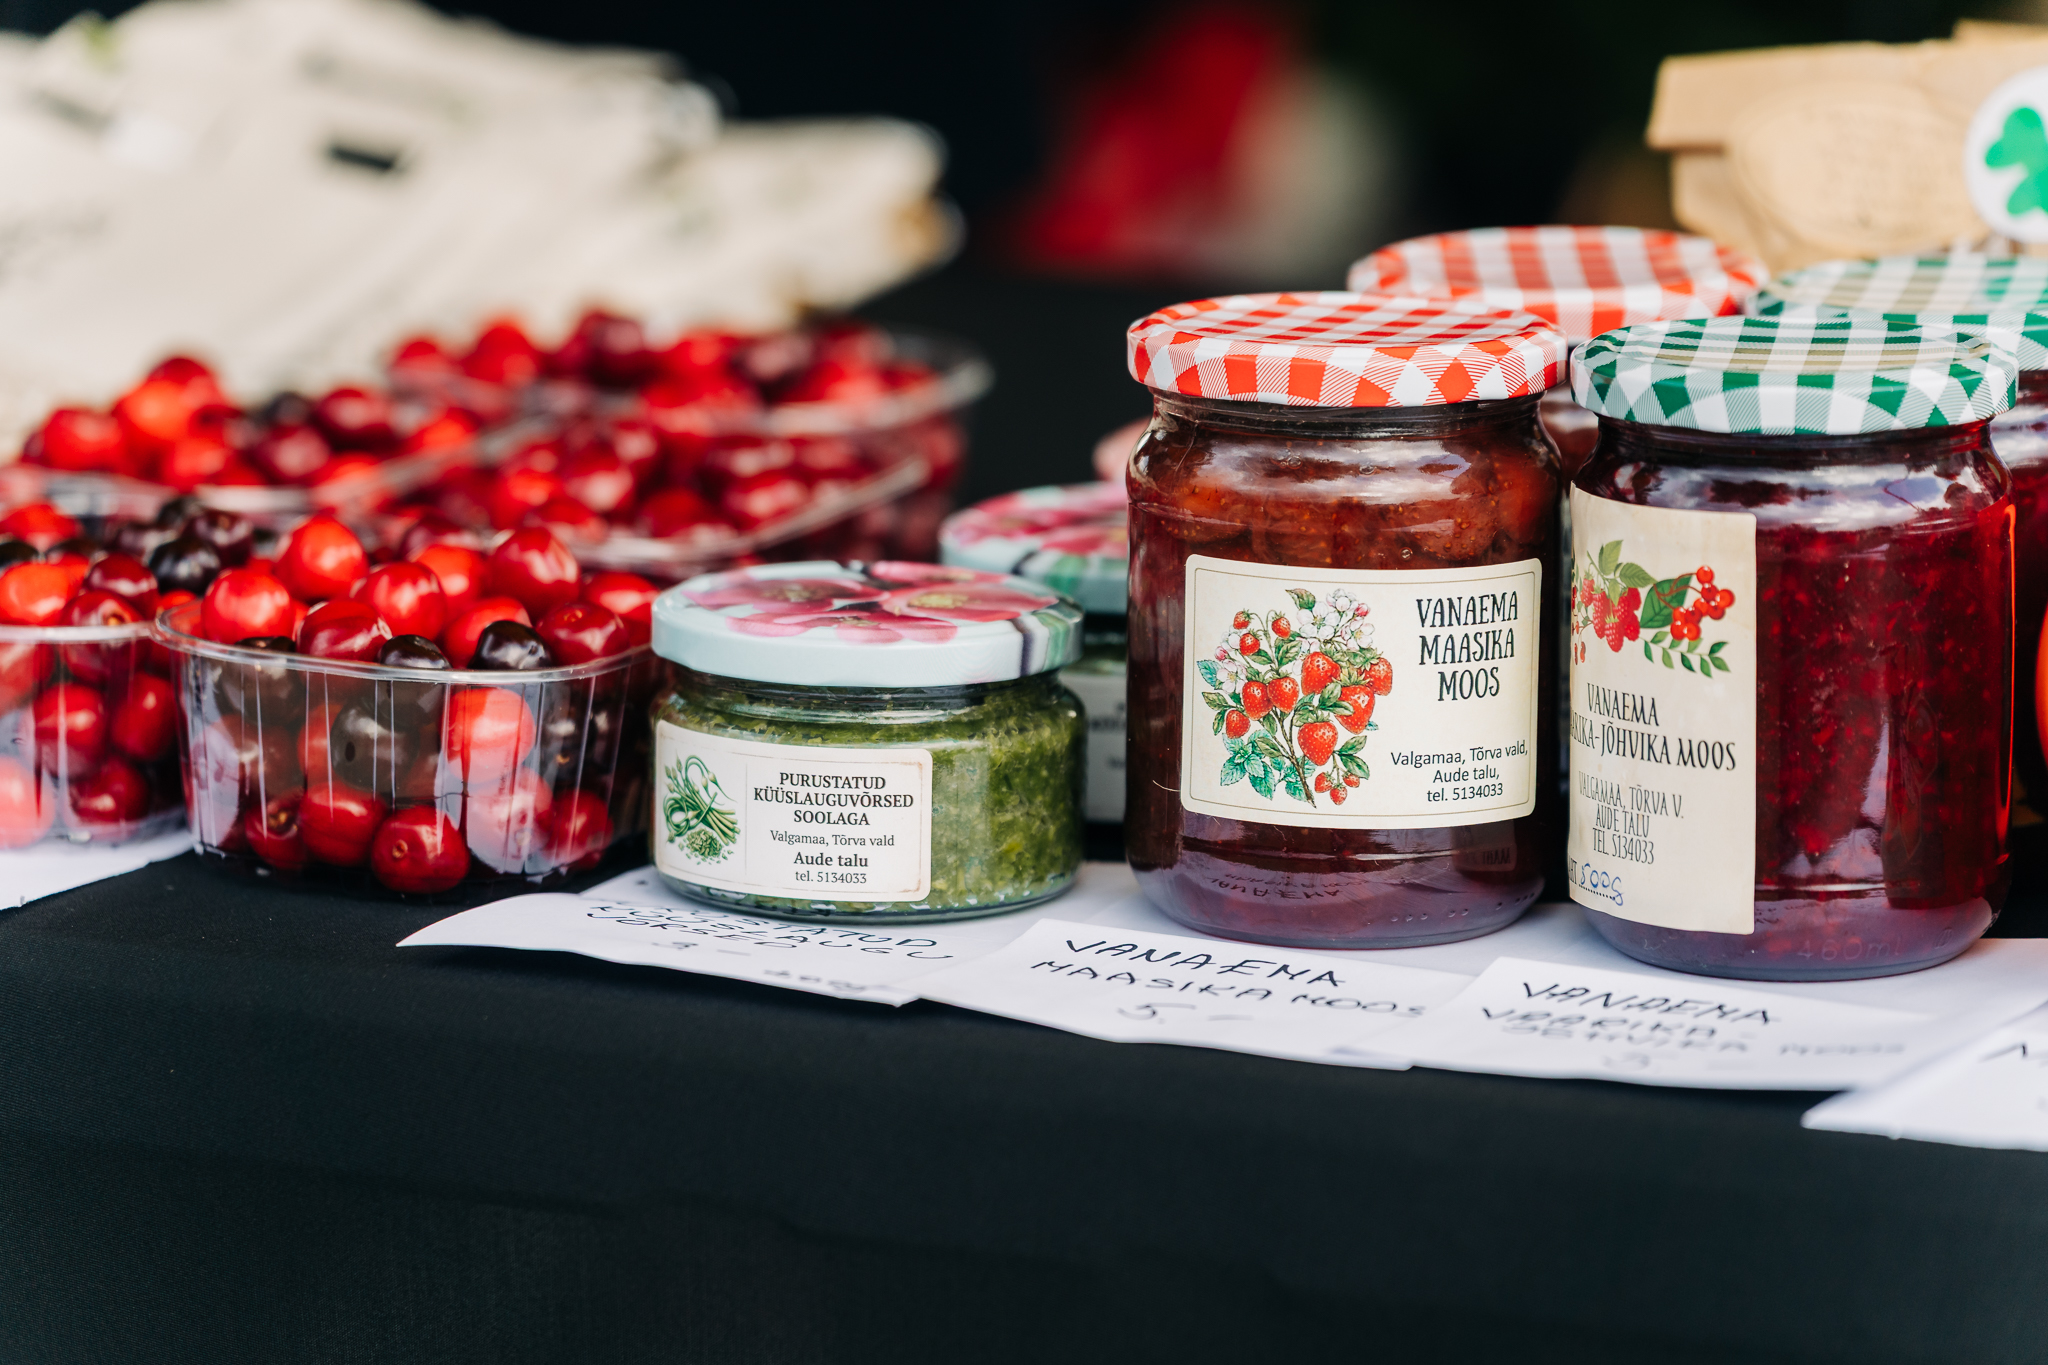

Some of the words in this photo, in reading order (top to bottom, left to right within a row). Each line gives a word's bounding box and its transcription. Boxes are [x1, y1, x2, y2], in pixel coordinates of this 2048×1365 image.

[1415, 590, 1519, 628] VANAEMA
[1418, 627, 1515, 666] MAASIKA
[1437, 666, 1501, 701] MOOS
[1587, 682, 1660, 727] VANAEMA
[1390, 751, 1467, 769] Valgamaa,
[1469, 746, 1503, 762] Tõrva
[1505, 739, 1529, 757] vald,
[1676, 738, 1736, 772] MOOS
[779, 772, 887, 791] PURUSTATUD
[1432, 767, 1470, 783] Aude
[1473, 765, 1500, 781] talu,
[753, 786, 915, 808] KÜÜSLAUGUVÕRSED
[1426, 788, 1449, 802] tel.
[1452, 782, 1504, 801] 5134033
[1578, 770, 1626, 810] VALGAMAA,
[1629, 784, 1669, 817] TÕRVA
[1672, 794, 1685, 819] V.
[793, 809, 870, 826] SOOLAGA
[1595, 803, 1620, 833] AUDE
[1622, 810, 1650, 838] TALU
[770, 830, 829, 847] Valgamaa,
[832, 834, 866, 847] Tõrva
[869, 835, 895, 847] vald
[1612, 834, 1655, 865] 5134033
[793, 851, 834, 867] Aude
[837, 853, 869, 868] talu
[795, 870, 814, 882] tel.
[816, 871, 867, 884] 5134033
[1066, 940, 1346, 988] VANAEMA
[1031, 961, 1273, 1001] MAASIKA
